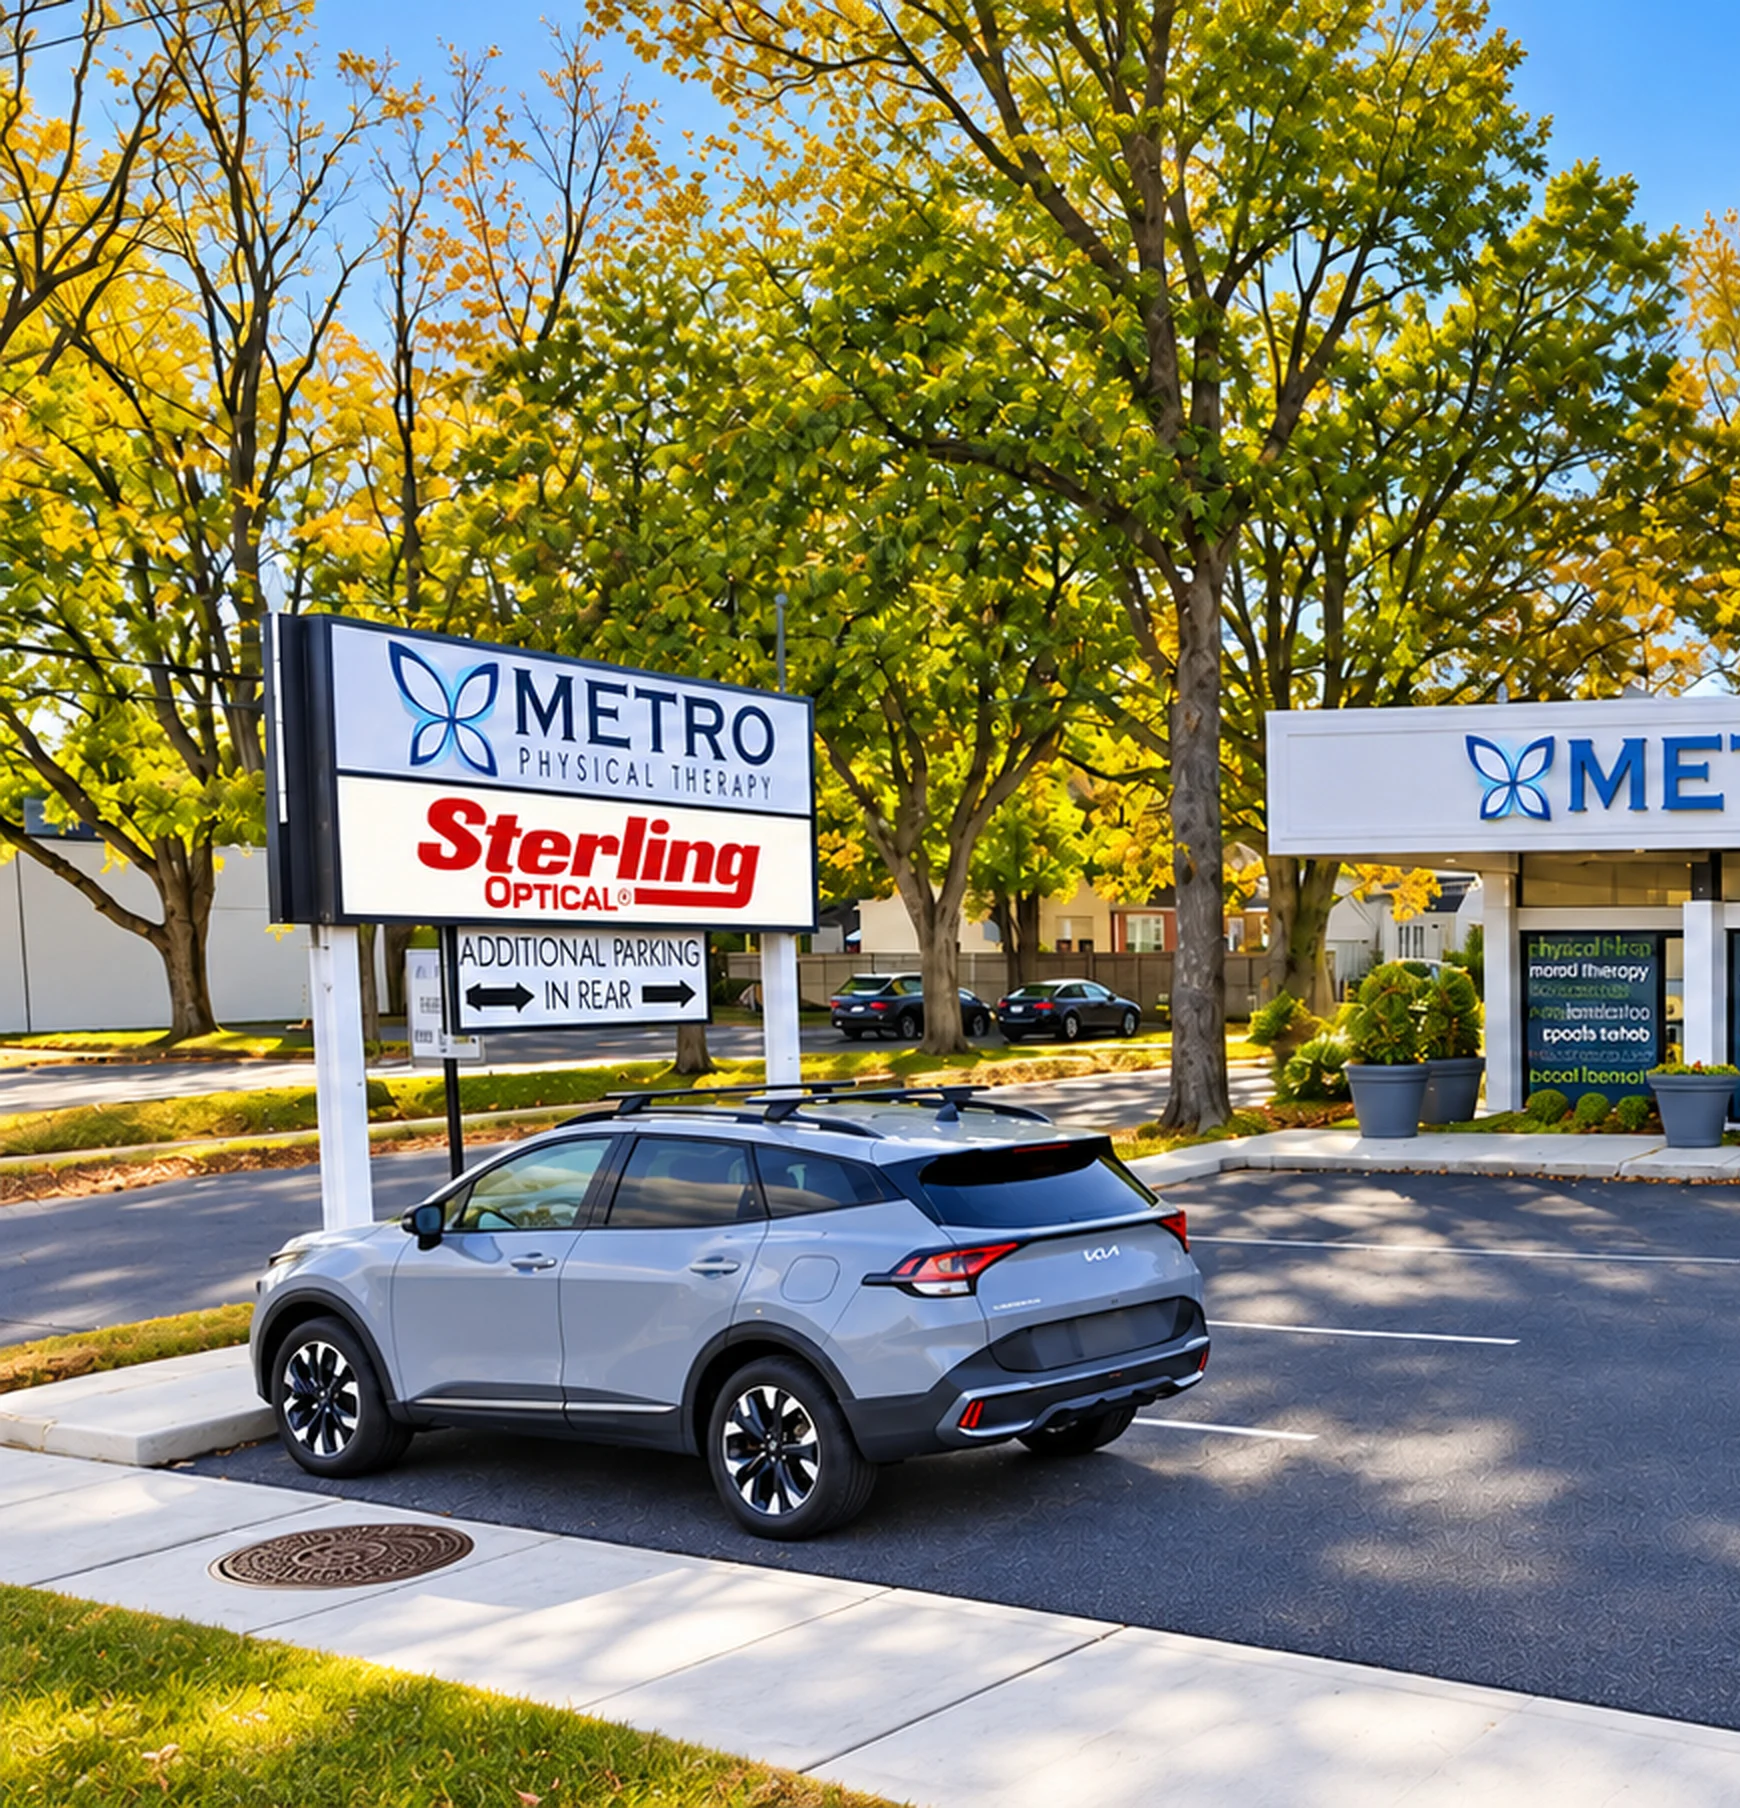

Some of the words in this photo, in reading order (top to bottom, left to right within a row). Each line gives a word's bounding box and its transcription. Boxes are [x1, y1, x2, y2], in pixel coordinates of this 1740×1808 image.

[515, 667, 775, 766] METRO
[519, 748, 654, 789] PHYSICAL
[671, 764, 773, 800] THERAPY
[417, 797, 761, 910] Sterling
[459, 936, 606, 967] ADDITIONAL
[614, 938, 701, 967] PARKING
[545, 981, 570, 1009] IN
[579, 981, 632, 1010] REAR
